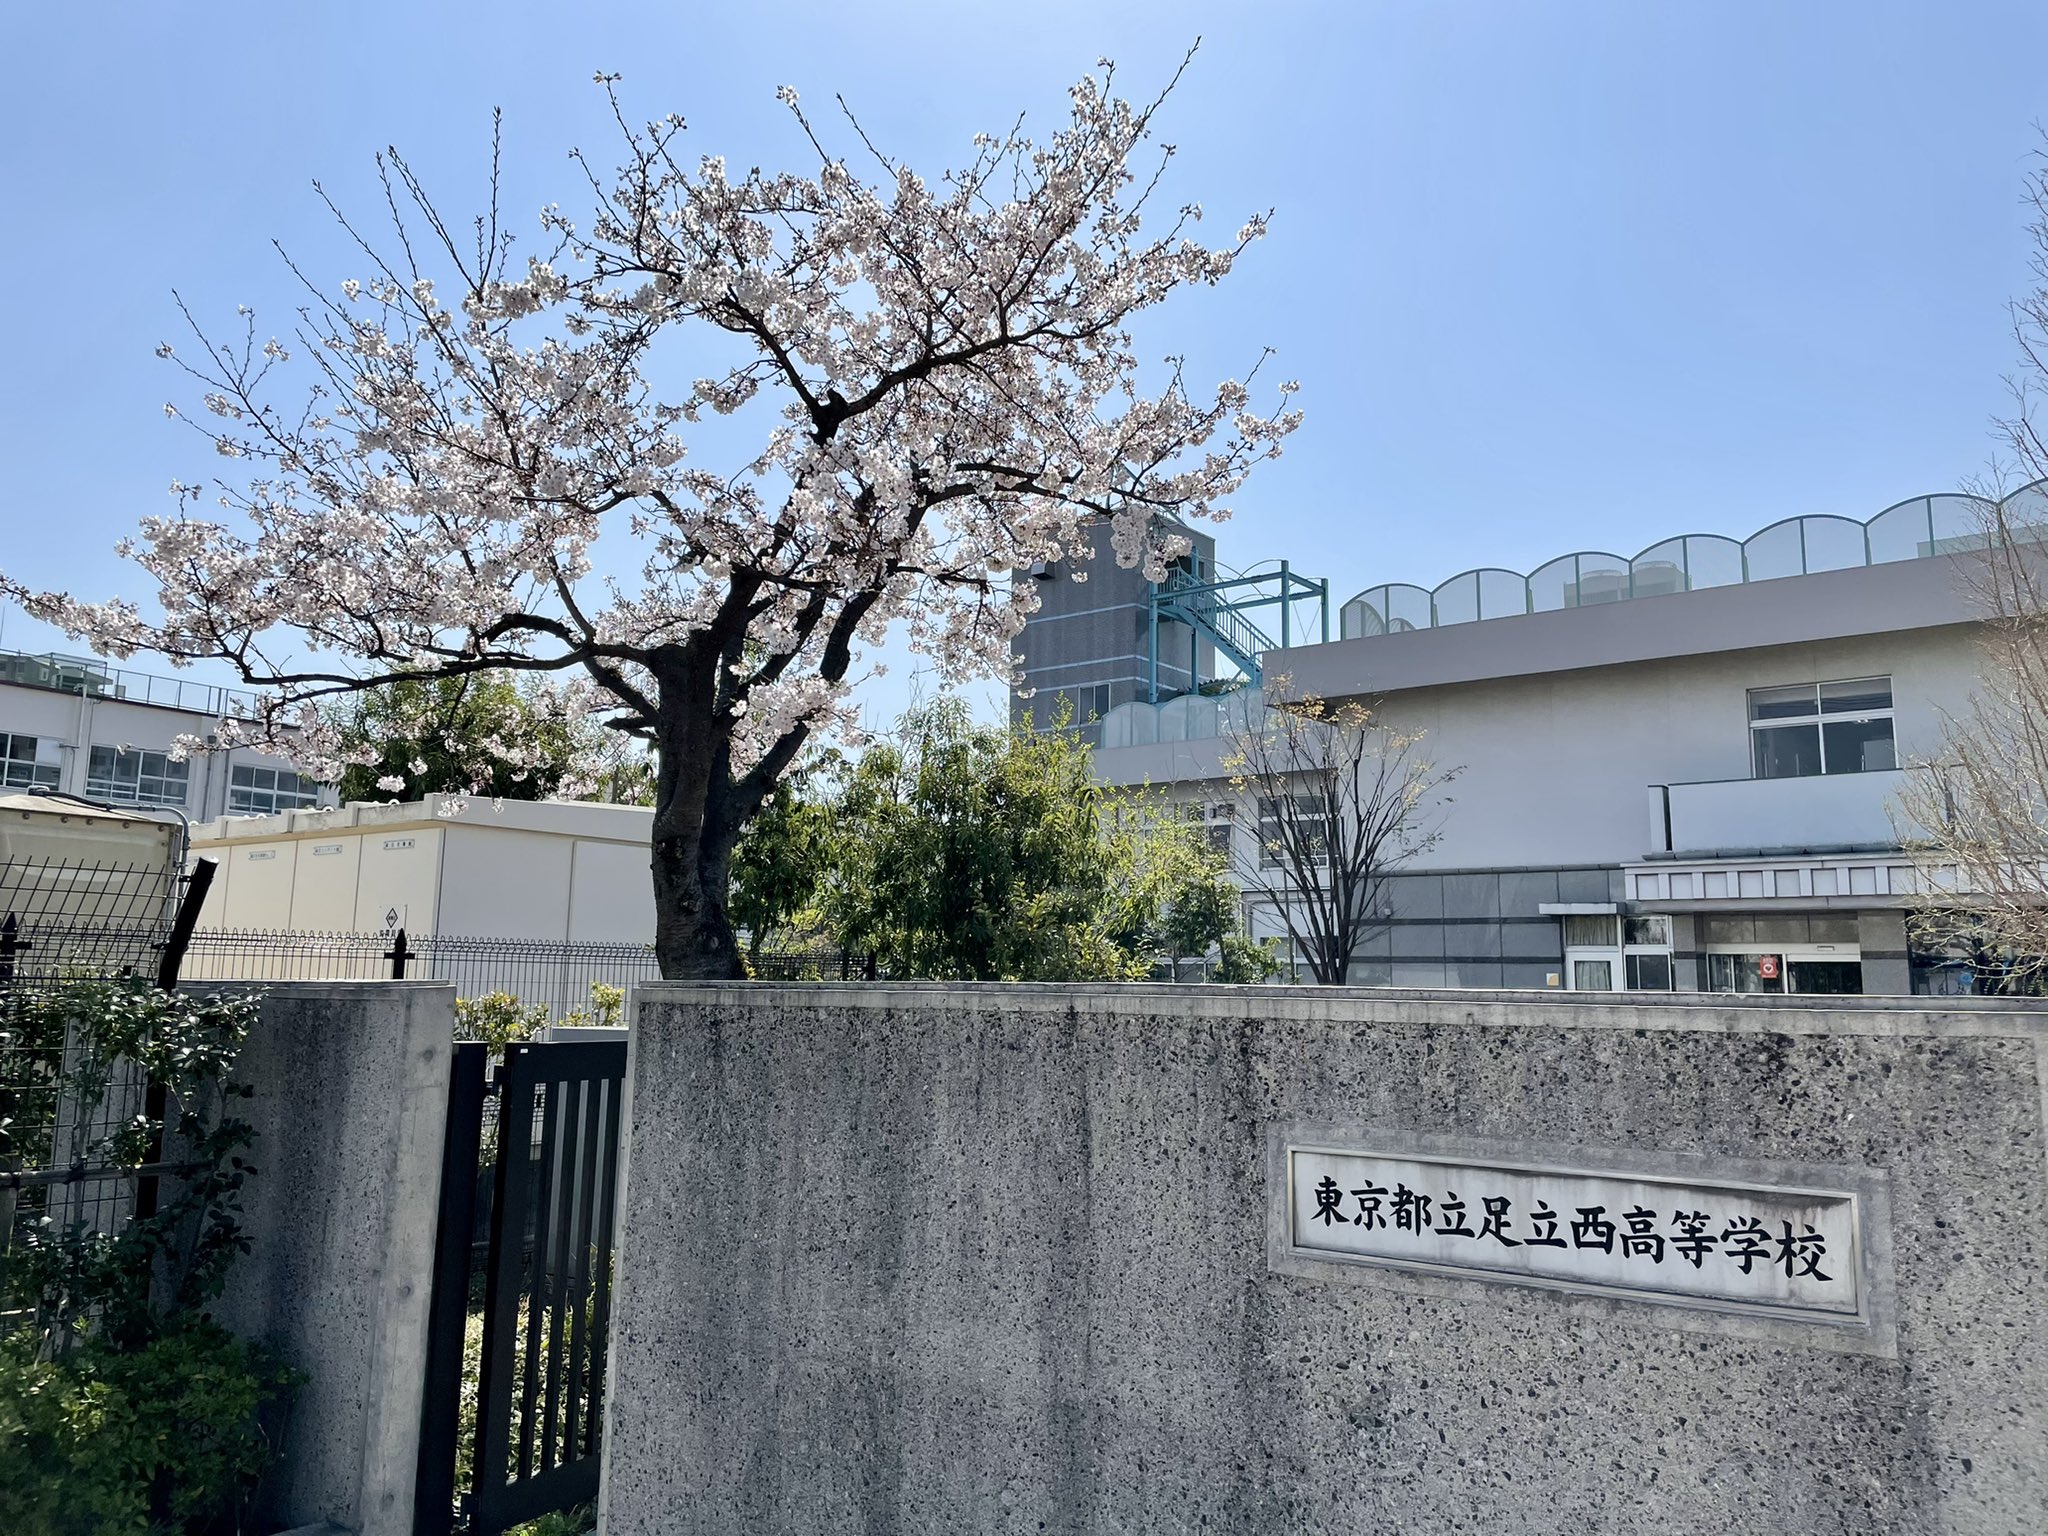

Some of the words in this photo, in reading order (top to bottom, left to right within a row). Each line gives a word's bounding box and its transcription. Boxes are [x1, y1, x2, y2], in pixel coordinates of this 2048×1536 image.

[1311, 1175, 1833, 1282] 東京都立足立西高等学校
